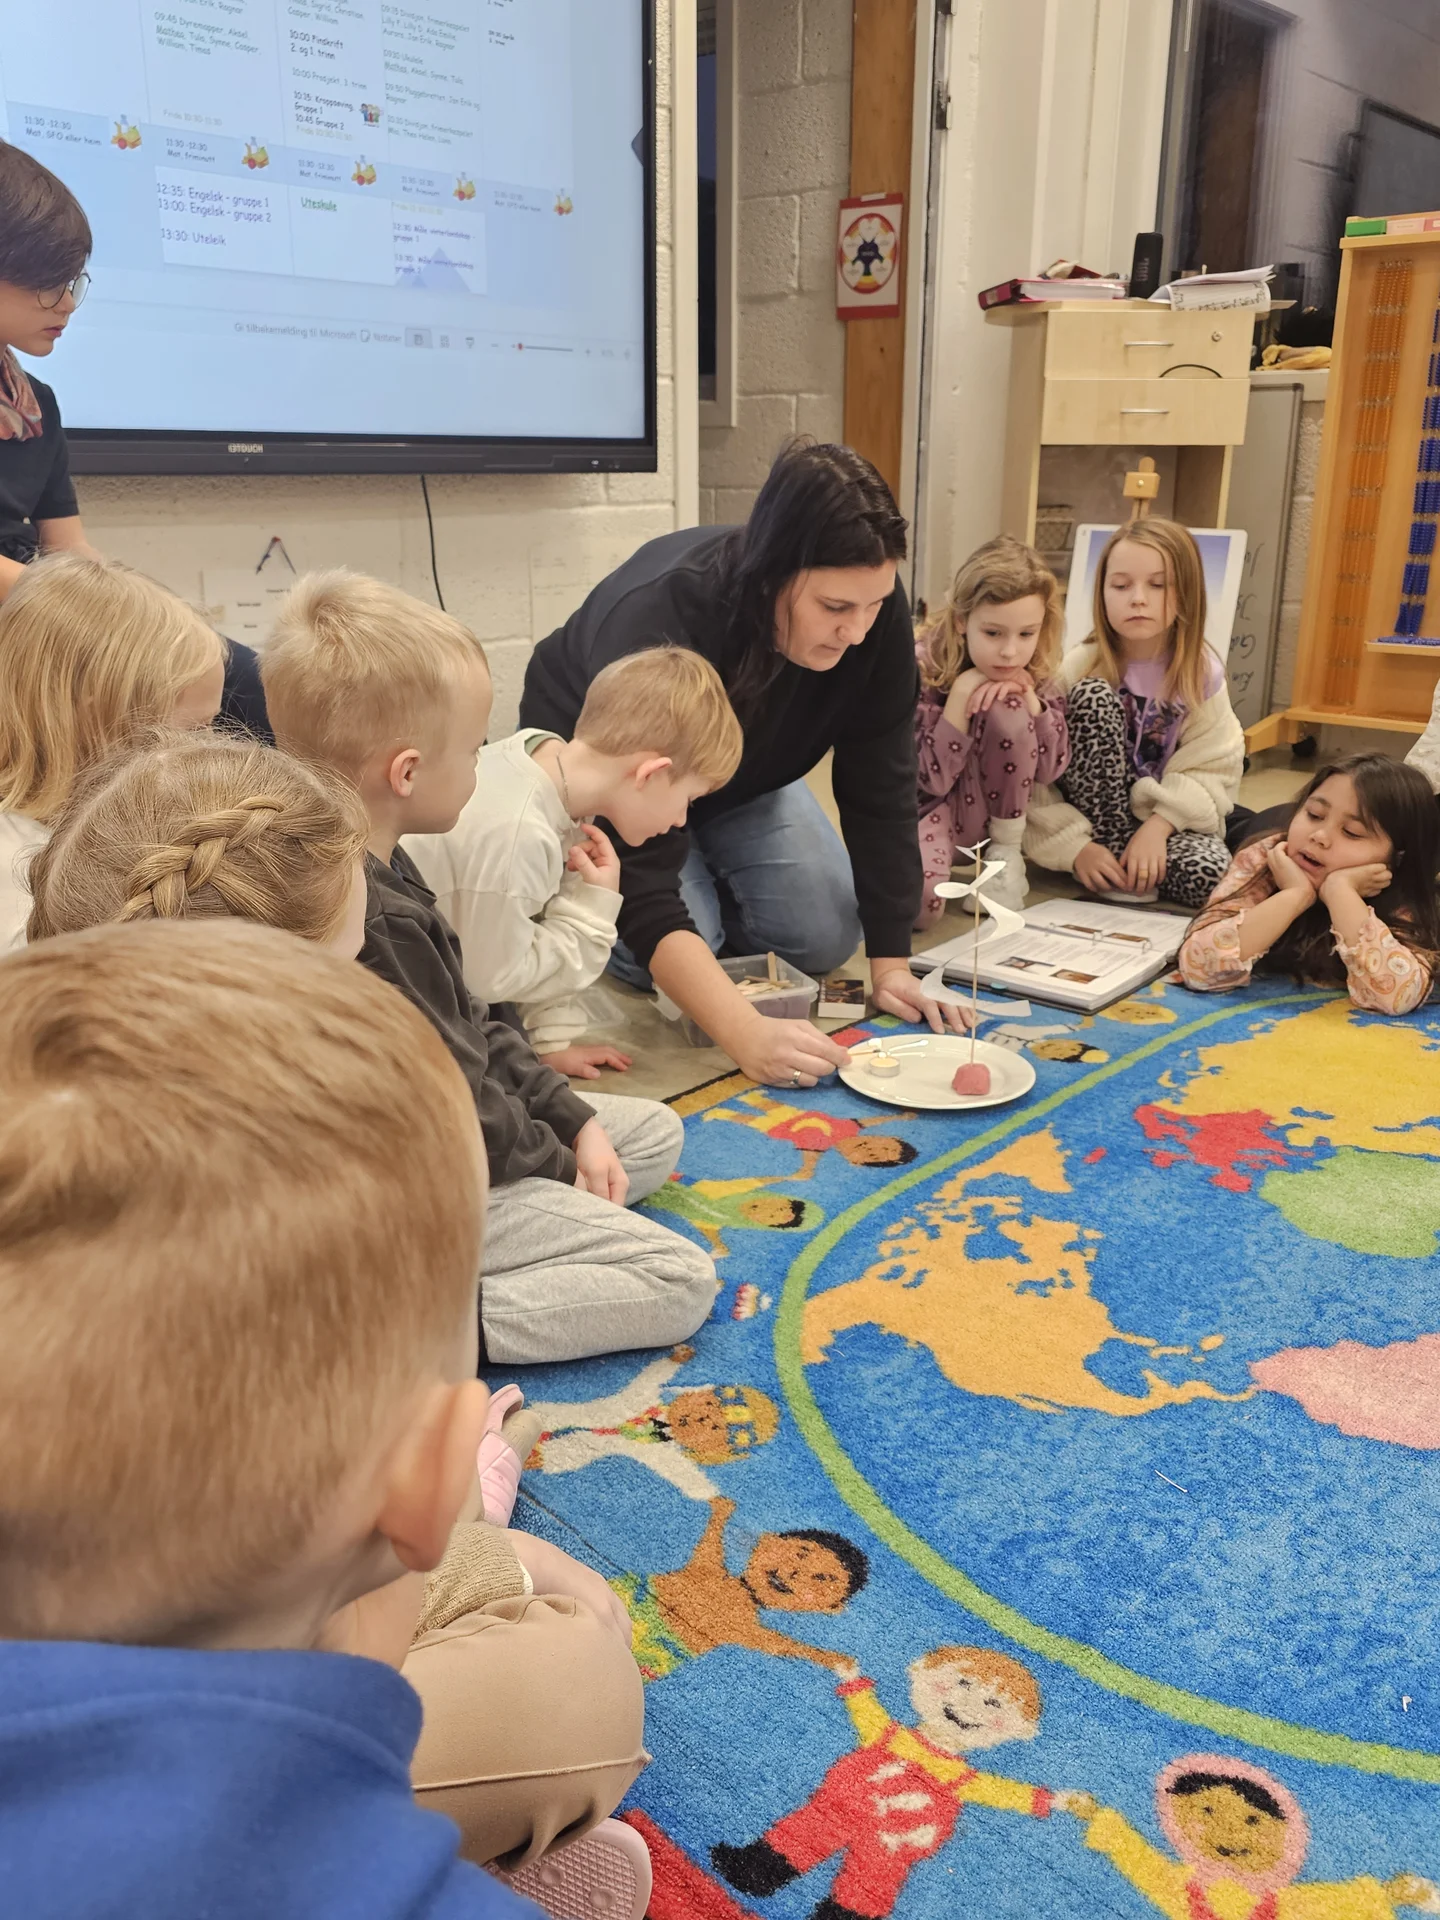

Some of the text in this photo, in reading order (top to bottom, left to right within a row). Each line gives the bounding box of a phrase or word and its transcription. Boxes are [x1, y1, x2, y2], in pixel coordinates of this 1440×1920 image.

[299, 46, 309, 57] og
[24, 115, 45, 127] 11:30
[65, 134, 82, 142] eller
[188, 187, 224, 203] Engelsk
[232, 197, 262, 208] gruppe
[264, 197, 269, 208] 1
[190, 202, 225, 218] Engelsk
[233, 211, 264, 223] gruppe
[266, 212, 272, 223] 2
[192, 231, 227, 246] Uteleik
[310, 328, 318, 337] til
[319, 329, 357, 340] Microsoft
